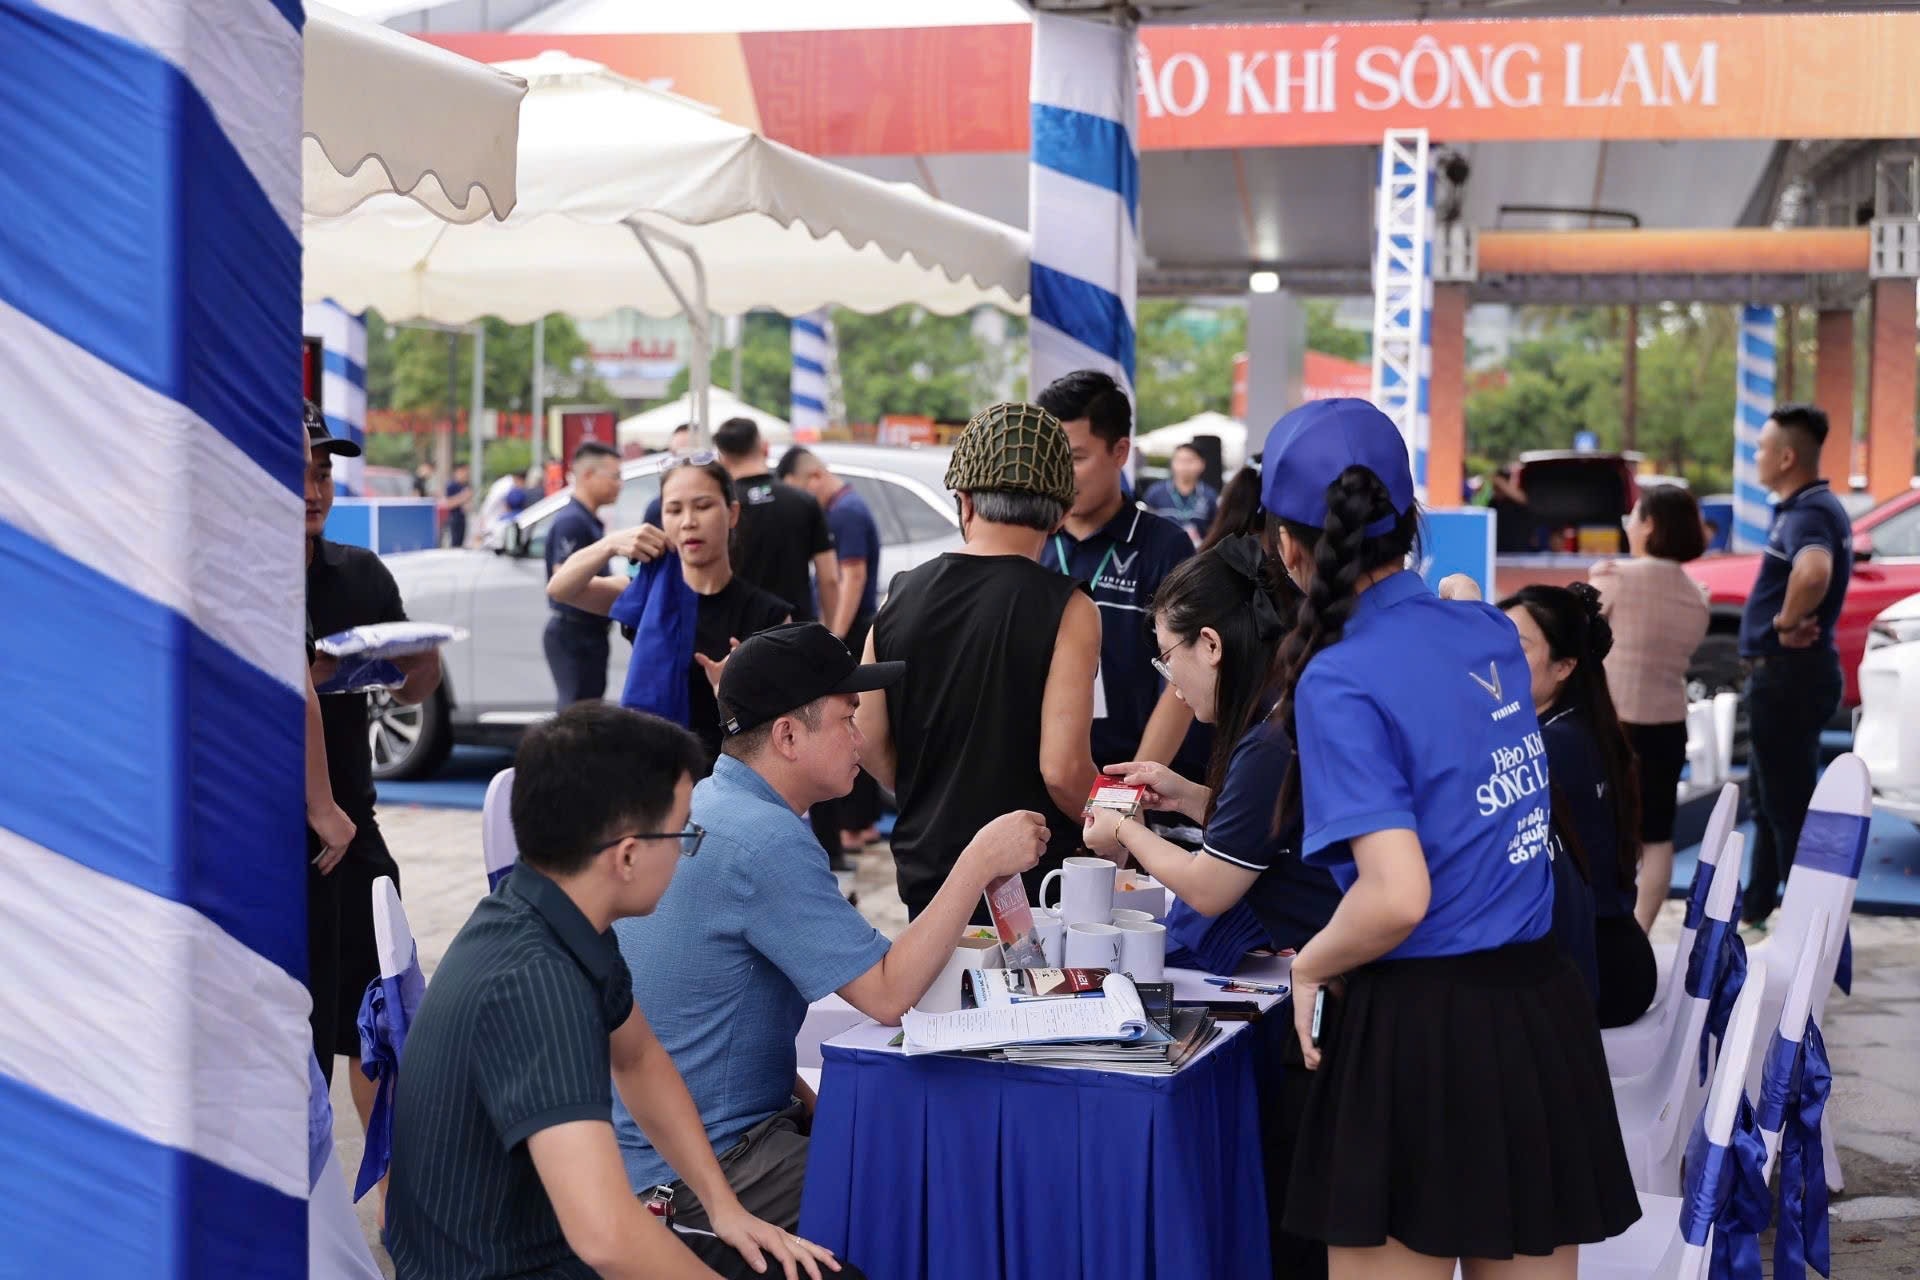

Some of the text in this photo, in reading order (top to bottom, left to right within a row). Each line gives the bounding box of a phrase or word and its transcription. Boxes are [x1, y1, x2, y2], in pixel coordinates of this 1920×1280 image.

[1137, 34, 1719, 117] ÀO KHÍ SÔNG LAM
[1491, 730, 1545, 775] Hào Kh
[1476, 759, 1549, 816] SÔNG L
